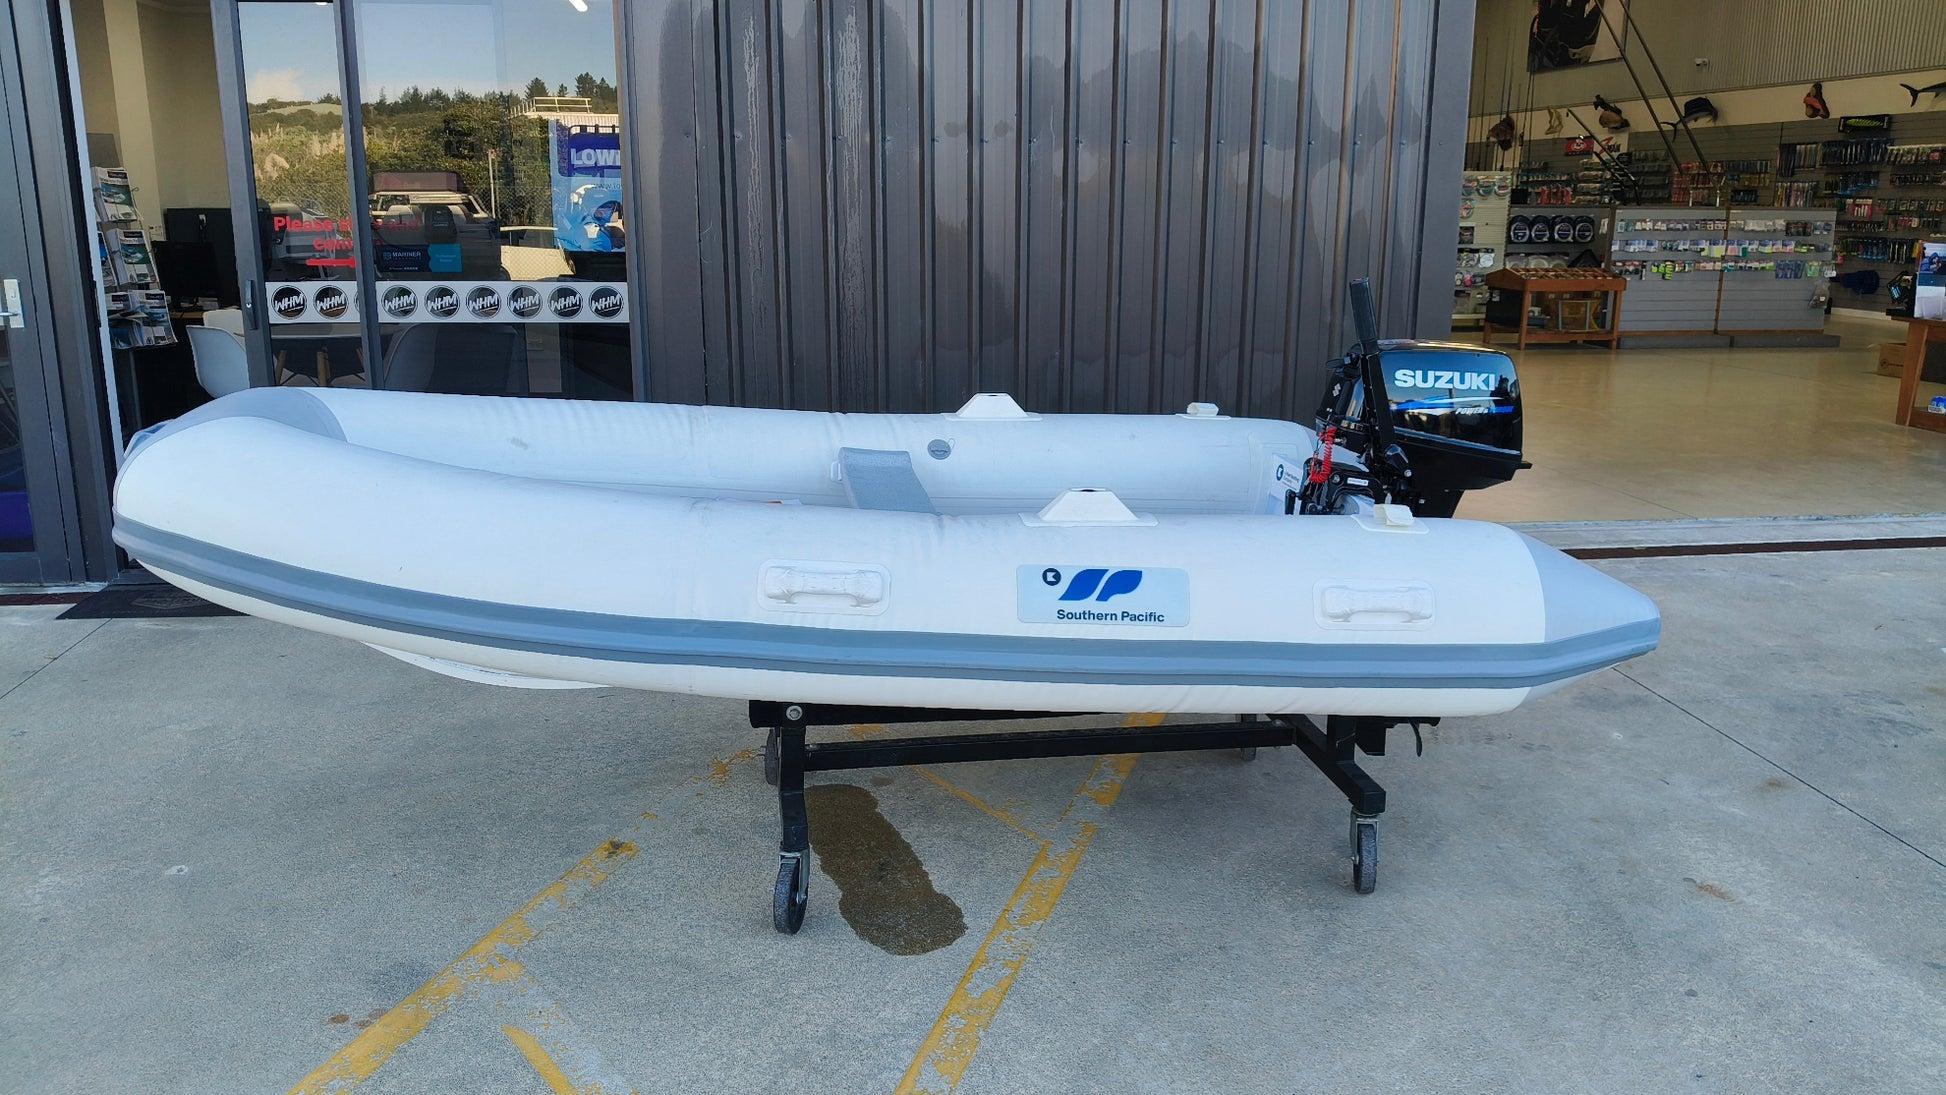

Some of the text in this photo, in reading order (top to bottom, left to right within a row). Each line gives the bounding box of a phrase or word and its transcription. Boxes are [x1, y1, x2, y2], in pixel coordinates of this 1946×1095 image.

[570, 148, 620, 166] LOW
[273, 216, 333, 232] Please
[274, 294, 303, 311] WHM
[316, 294, 345, 311] WHM
[385, 294, 415, 311] WHM
[428, 294, 457, 311] WHM
[469, 294, 498, 311] WHM
[510, 294, 540, 311] WHM
[551, 294, 580, 311] WHM
[592, 294, 621, 311] WHM
[1394, 369, 1495, 390] SUZUKI
[1057, 609, 1165, 622] Southern Pacific
